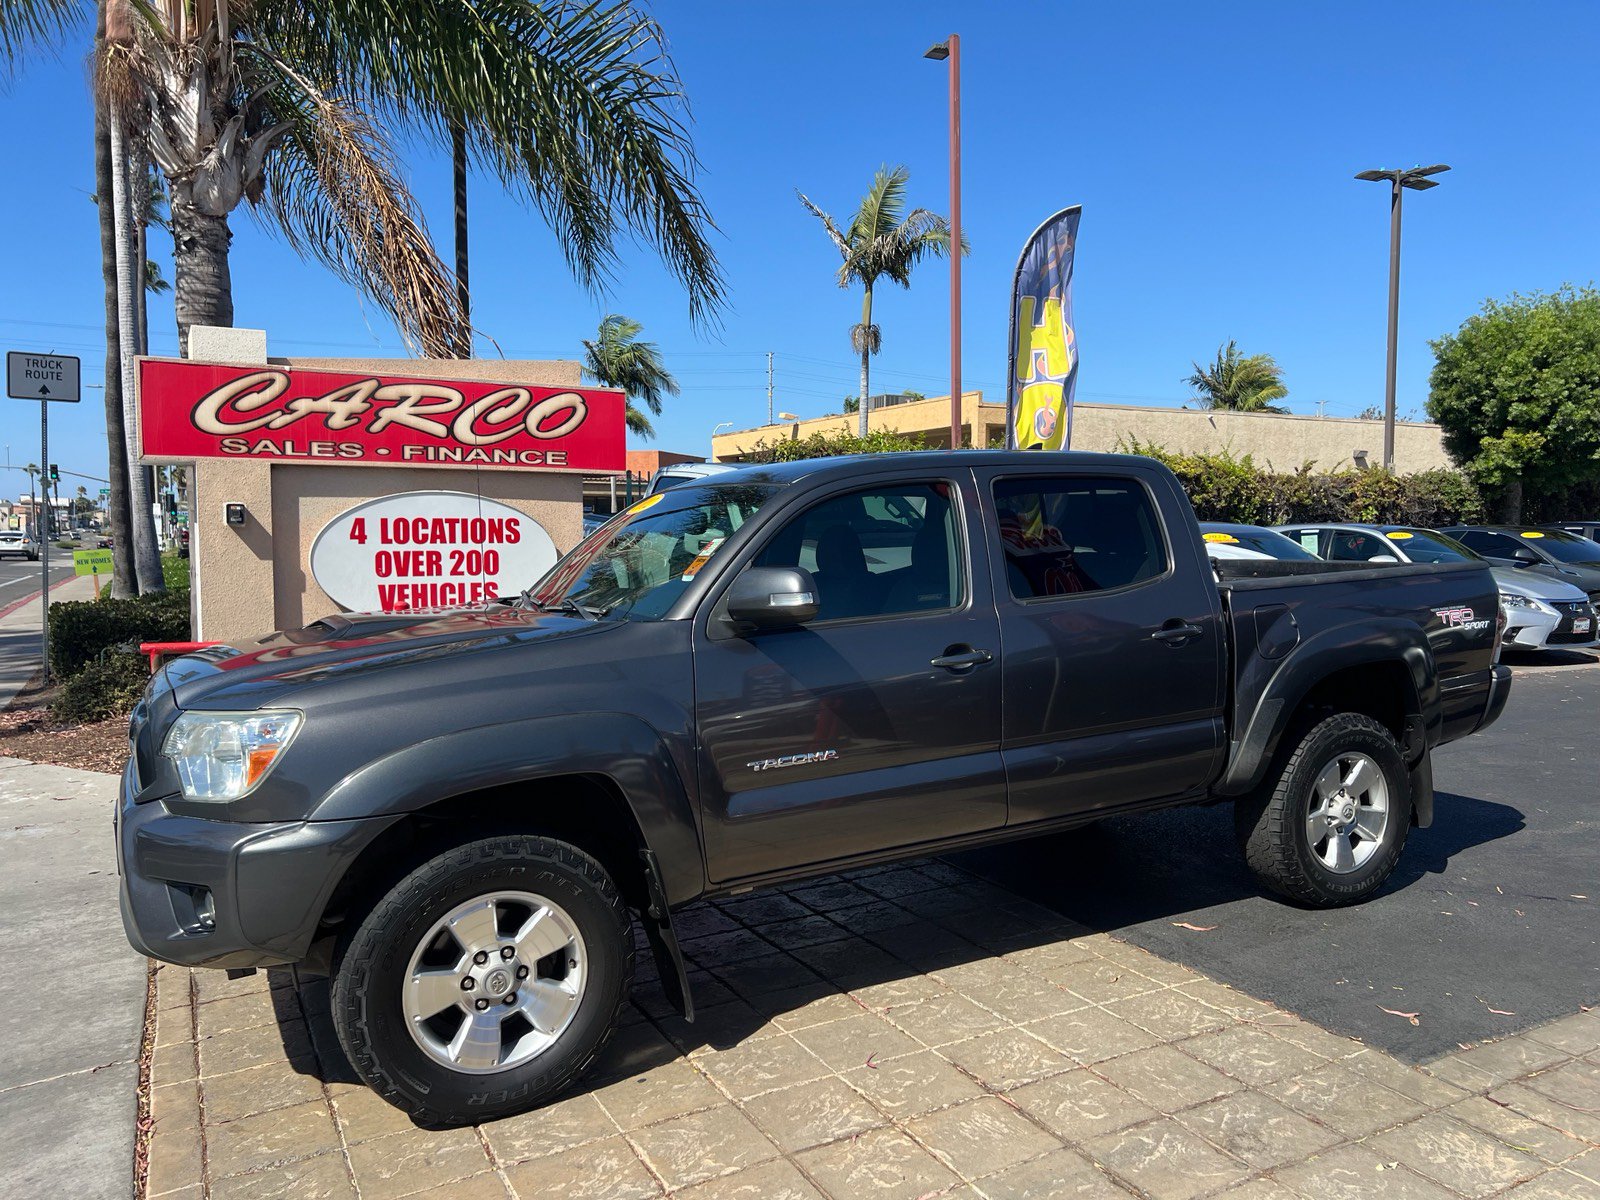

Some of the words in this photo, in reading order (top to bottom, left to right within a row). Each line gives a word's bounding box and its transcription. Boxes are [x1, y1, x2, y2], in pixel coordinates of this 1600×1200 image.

[25, 358, 63, 370] TRUCK
[25, 369, 63, 381] ROUTE
[191, 371, 588, 445] CARCO
[220, 437, 365, 459] SALES
[402, 444, 568, 466] FINANCE
[350, 517, 368, 544] 4
[380, 517, 521, 545] LOCATIONS
[76, 558, 89, 566] NEW
[90, 557, 112, 565] HOMES
[375, 550, 443, 577] OVER
[449, 550, 501, 576] 200
[1435, 608, 1474, 627] TRD
[1464, 620, 1490, 631] SPORT
[746, 749, 840, 772] TACOMA
